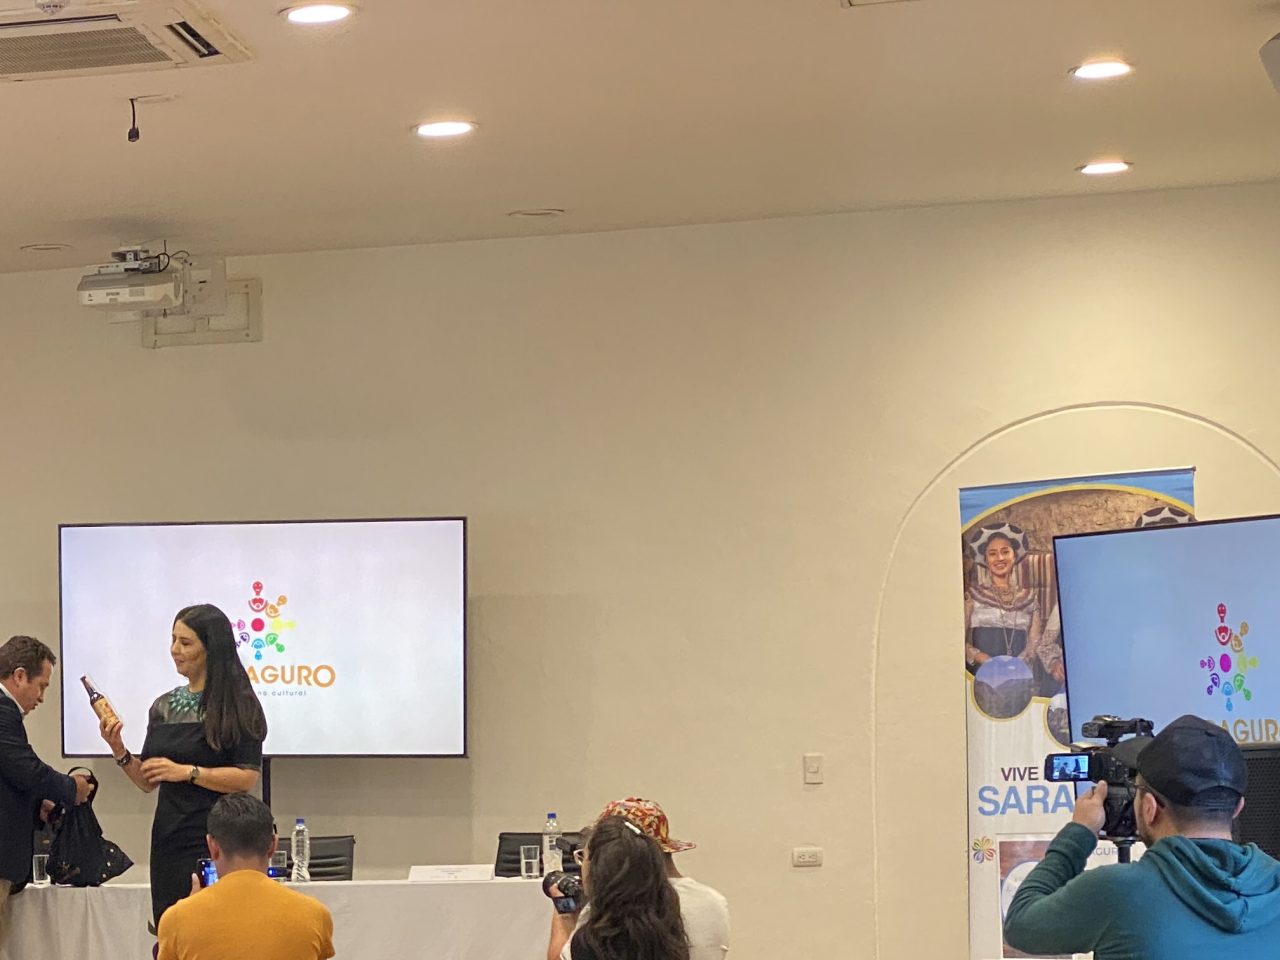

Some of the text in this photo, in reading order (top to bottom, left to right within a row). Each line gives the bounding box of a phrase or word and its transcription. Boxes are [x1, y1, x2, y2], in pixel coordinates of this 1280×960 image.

[247, 664, 336, 688] AGURO
[271, 688, 307, 697] cultural
[1000, 766, 1039, 782] VIVE
[977, 784, 1074, 817] SARA
